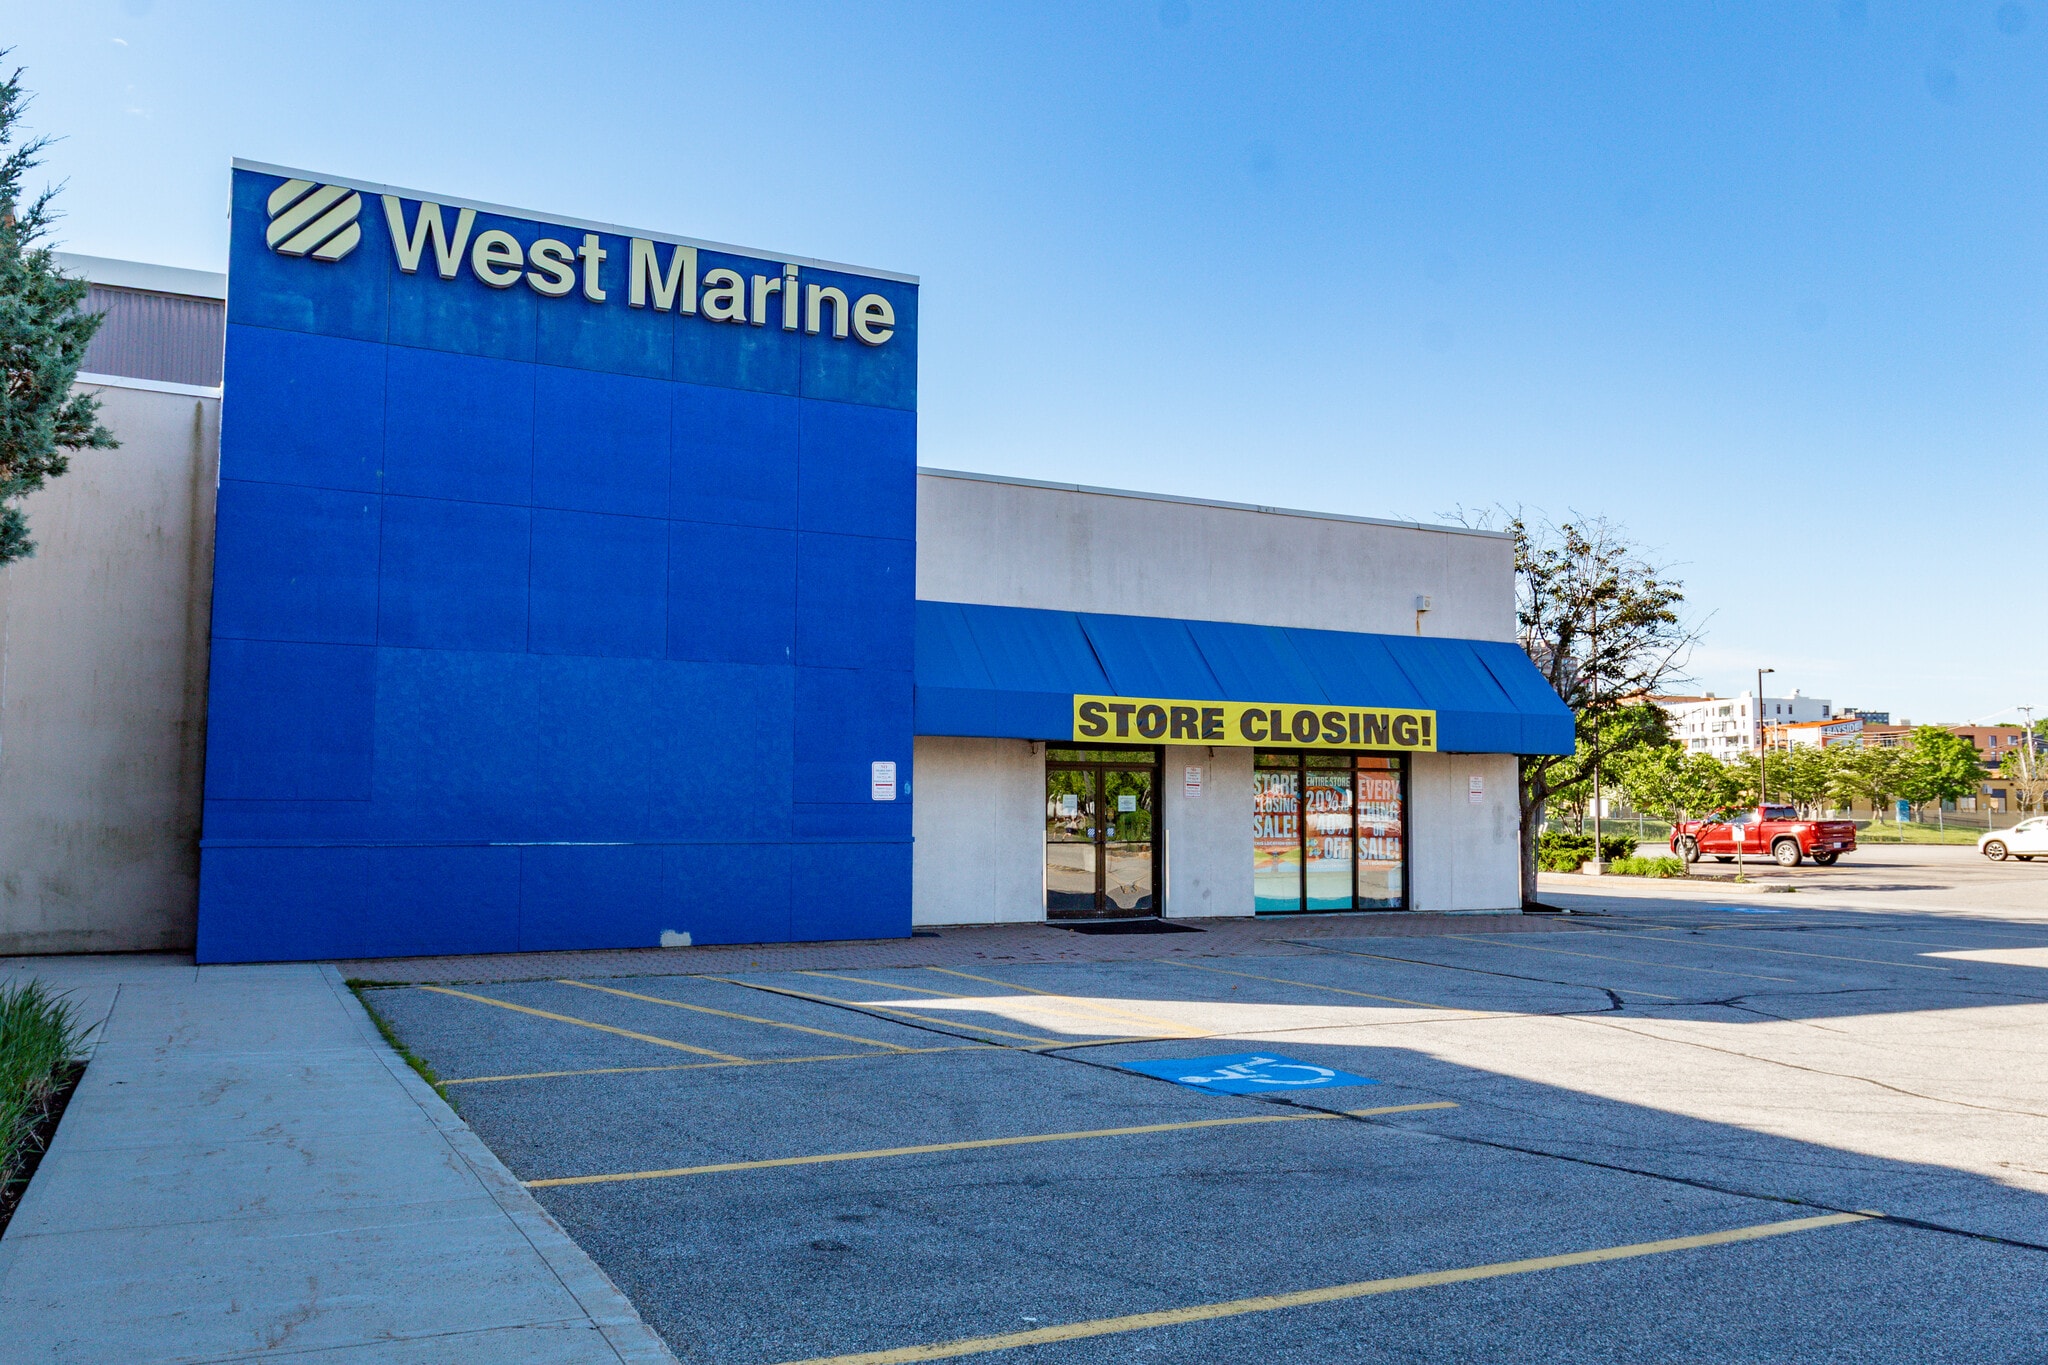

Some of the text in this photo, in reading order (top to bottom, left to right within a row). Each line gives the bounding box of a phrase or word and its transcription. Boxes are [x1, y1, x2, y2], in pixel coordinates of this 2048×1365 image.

[382, 194, 896, 347] West Marine
[1078, 702, 1432, 746] STORE CLOSING!
[1826, 723, 1861, 735] BAYSIDE
[1254, 774, 1298, 795] STORE
[1306, 776, 1350, 787] ENTIRE STORE
[1358, 779, 1400, 800] EVERY
[1254, 797, 1298, 813] CLOSING
[1306, 790, 1338, 812] 20%
[1359, 801, 1399, 820] THING
[1254, 814, 1298, 838] SALE!
[1373, 822, 1385, 836] ON
[1324, 837, 1350, 859] OFF
[1358, 837, 1400, 860] SALE!
